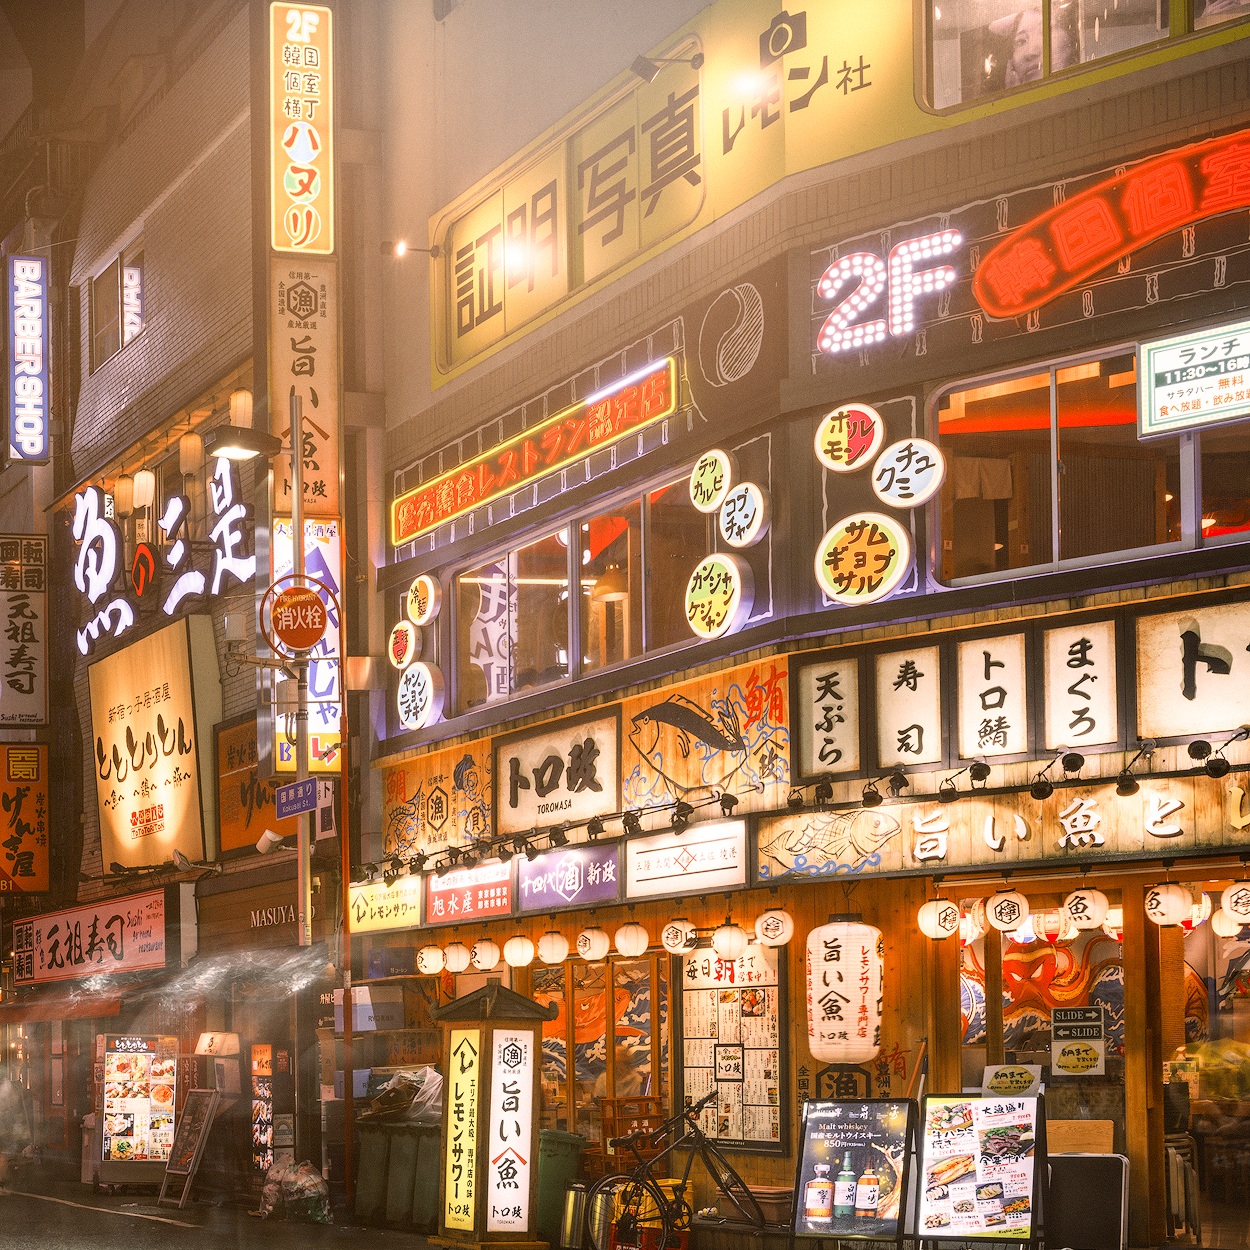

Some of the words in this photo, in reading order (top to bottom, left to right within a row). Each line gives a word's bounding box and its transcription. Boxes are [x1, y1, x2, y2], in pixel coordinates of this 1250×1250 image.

[286, 10, 319, 42] 2F
[284, 46, 319, 67] 韓国
[285, 71, 319, 93] 個室
[284, 99, 319, 118] 横丁
[283, 126, 320, 246] ハヌリ
[455, 85, 702, 338] 証明写真
[292, 289, 313, 312] 漁
[818, 228, 961, 354] 2F
[1179, 338, 1240, 365] ランチ
[1218, 375, 1243, 390] 無料
[277, 605, 323, 630] 消火栓
[4, 594, 39, 694] 元祖寿司
[743, 665, 788, 730] 鮪
[1066, 637, 1098, 737] まぐろ
[892, 660, 925, 756] 寿司
[977, 651, 1010, 750] トロ鯖
[814, 671, 844, 766] 天ぷら
[509, 737, 603, 810] トロ政
[280, 783, 312, 803] 国際通り
[35, 792, 46, 847] 炭火串焼
[283, 802, 300, 813] Kokusai
[537, 800, 572, 814] TOROMASA
[2, 786, 36, 877] げんき屋
[0, 880, 13, 890] B1
[521, 872, 556, 897] 十四代
[559, 862, 579, 891] 酒
[587, 859, 616, 885] 新政
[371, 903, 416, 919] レモンサワー
[432, 890, 473, 916] 旭水産
[1068, 896, 1091, 921] 魚
[127, 909, 143, 928] Sushi
[251, 905, 295, 927] MASUYA
[47, 914, 125, 969] 元祖寿司
[821, 938, 844, 1022] 旨い魚
[857, 946, 870, 1038] レモンサワー専門店
[1056, 1011, 1084, 1020] SLIDE
[820, 1031, 849, 1041] トロ政
[1071, 1028, 1100, 1037] SLIDE
[719, 1062, 741, 1074] トロ政
[452, 1082, 464, 1199] レモンサワー
[497, 1080, 521, 1190] 旨い魚
[823, 1140, 846, 1148] 850円
[448, 1202, 470, 1218] トロ政
[492, 1205, 523, 1219] トロ政
